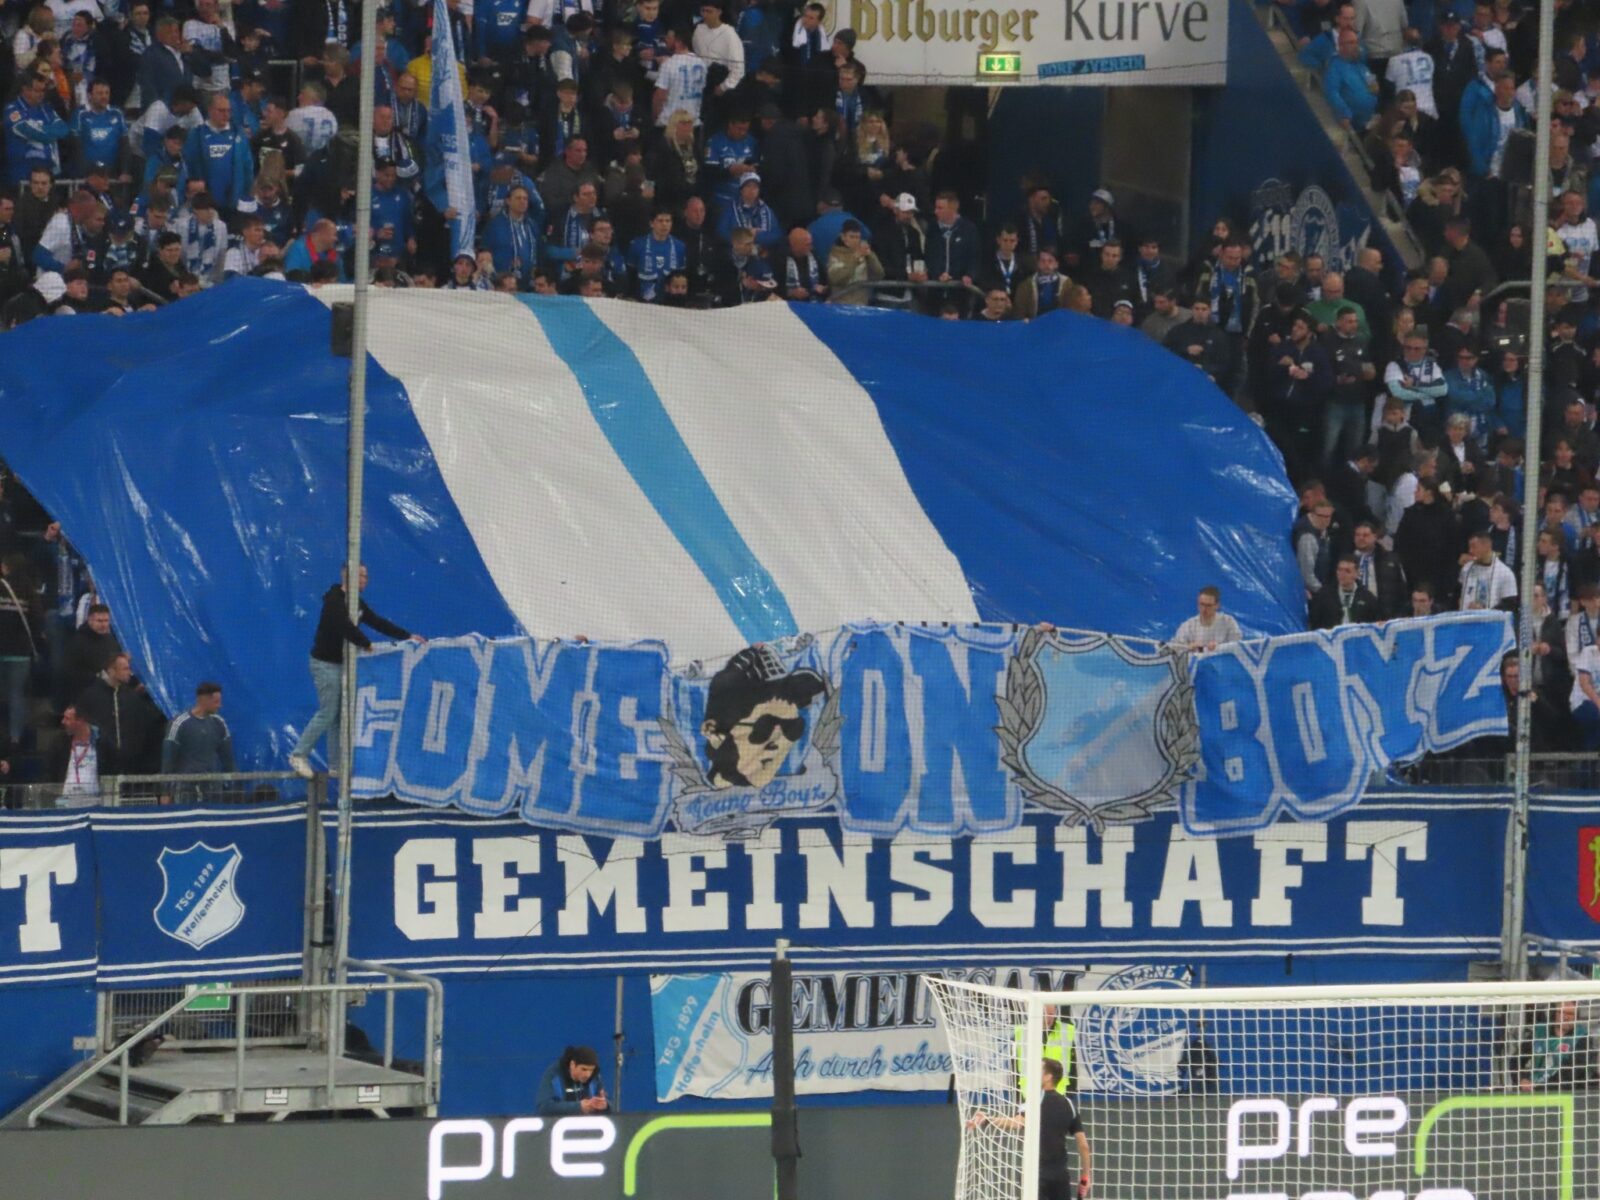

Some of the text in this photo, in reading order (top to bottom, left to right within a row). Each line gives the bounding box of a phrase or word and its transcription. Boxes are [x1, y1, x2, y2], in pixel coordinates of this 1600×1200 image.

[1064, 0, 1208, 42] Kurve
[678, 63, 705, 100] 12
[1400, 56, 1432, 87] 12
[838, 623, 1022, 836] ON
[1188, 611, 1515, 838] BOYZ
[759, 779, 827, 807] Boyz
[174, 862, 215, 913] TSG 1899
[393, 819, 1428, 943] GEMEINSCHAFT
[659, 995, 699, 1067] TSG 1899
[819, 1046, 885, 1077] durch
[428, 1116, 617, 1200] pre
[1227, 1096, 1408, 1180] pre
